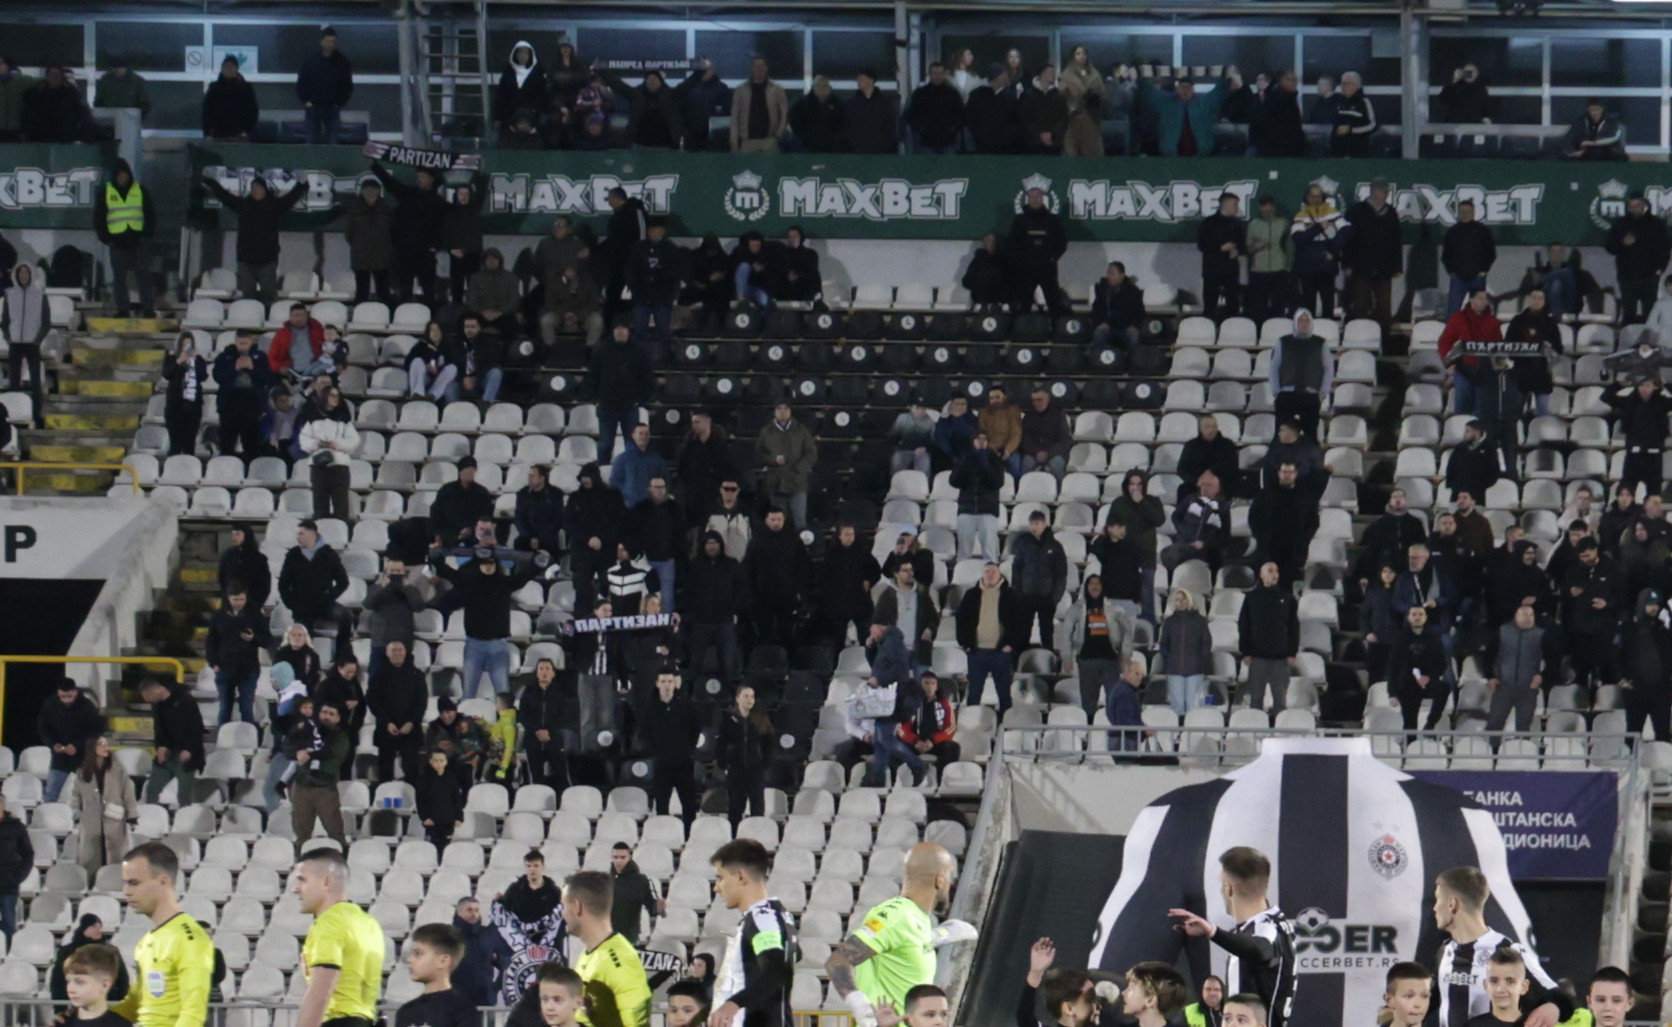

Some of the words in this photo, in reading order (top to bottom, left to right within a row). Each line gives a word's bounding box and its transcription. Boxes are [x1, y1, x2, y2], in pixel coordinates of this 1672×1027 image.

[389, 147, 451, 169] PARTIZAN
[0, 167, 101, 210] BET
[779, 176, 969, 220] MAXBET
[1068, 179, 1259, 223] MAXBET
[4, 525, 37, 563] P
[575, 613, 669, 632] ПАРТИЗАН
[1463, 791, 1523, 806] АНКА
[1493, 812, 1577, 827] ШТАНСКА
[1502, 834, 1591, 851] ДИОНИЦА
[1300, 957, 1400, 969] CCERBET.RS
